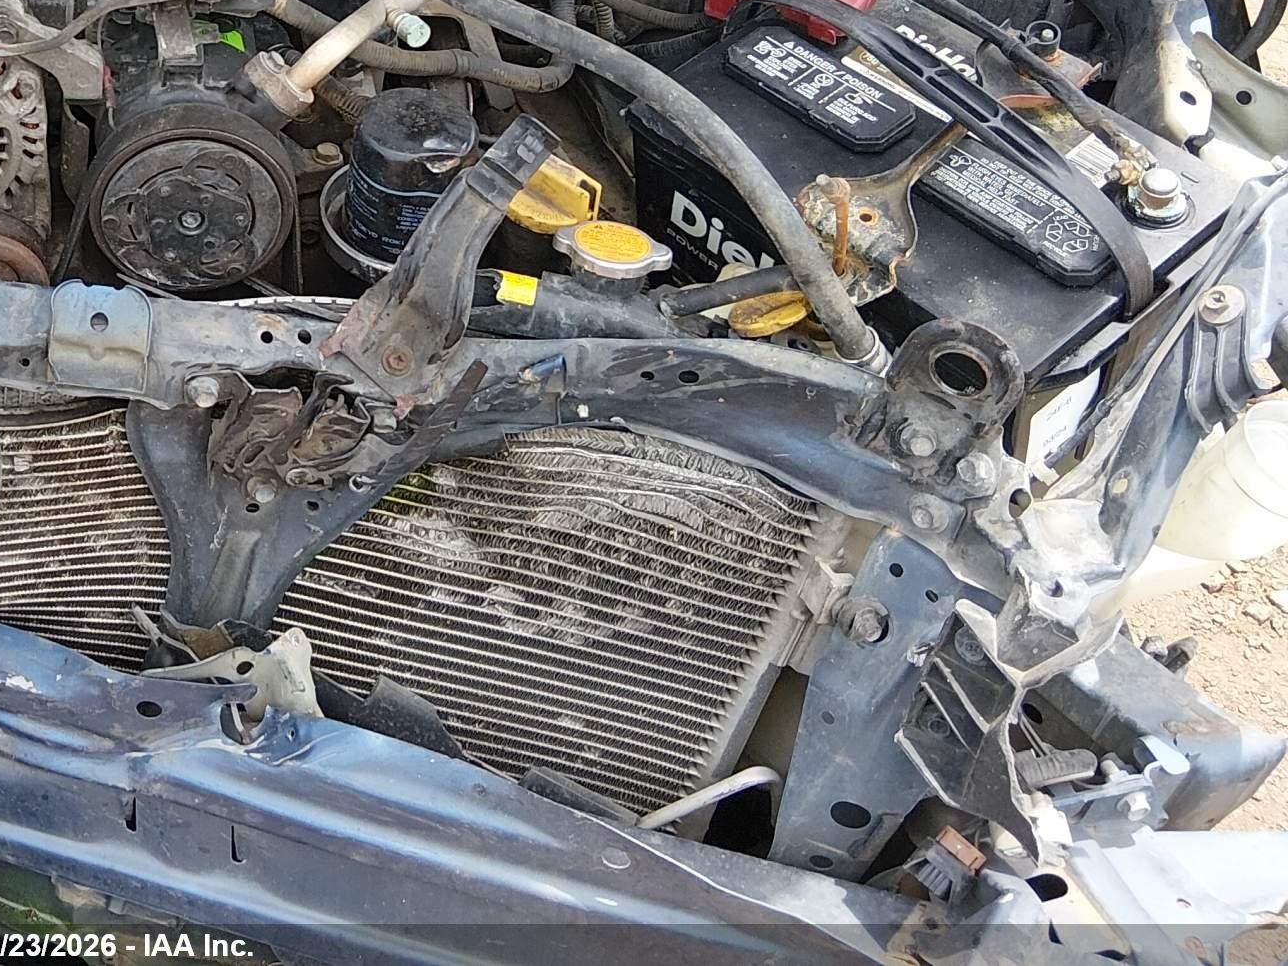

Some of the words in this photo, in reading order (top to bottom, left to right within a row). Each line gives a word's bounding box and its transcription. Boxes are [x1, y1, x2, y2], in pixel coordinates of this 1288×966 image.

[793, 45, 836, 74] DANGER
[841, 71, 883, 99] POISON
[666, 228, 719, 270] POWER
